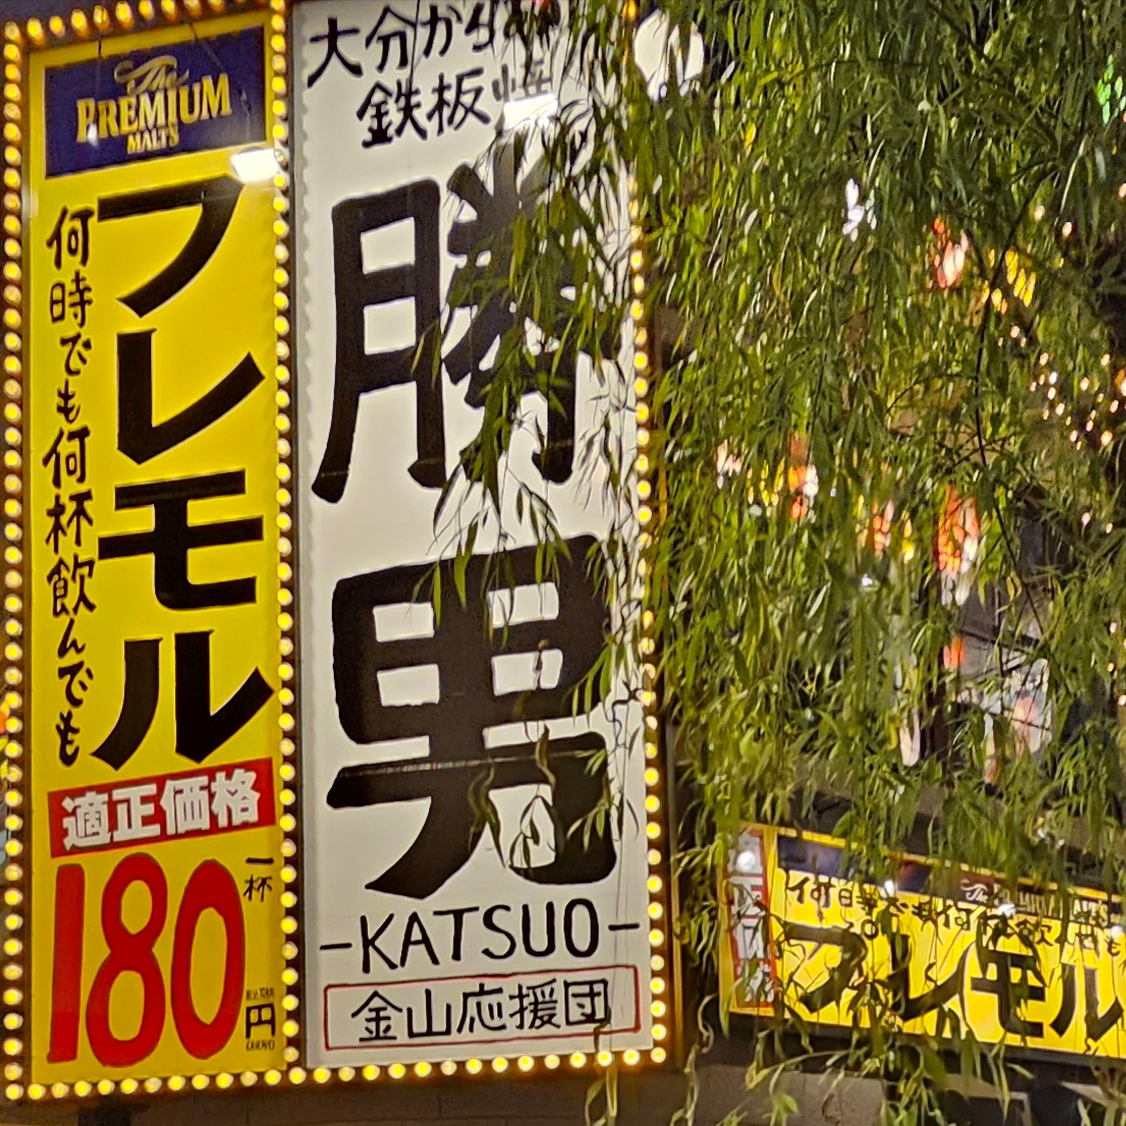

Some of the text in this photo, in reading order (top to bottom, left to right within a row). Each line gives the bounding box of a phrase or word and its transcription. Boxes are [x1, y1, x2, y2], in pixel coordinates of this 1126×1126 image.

[76, 72, 233, 143] PREMIUM
[114, 55, 190, 96] The
[41, 205, 98, 769] 何時でも何杯飲んでも
[61, 769, 262, 853] 適正価格
[349, 977, 611, 1043] 金山応援団
